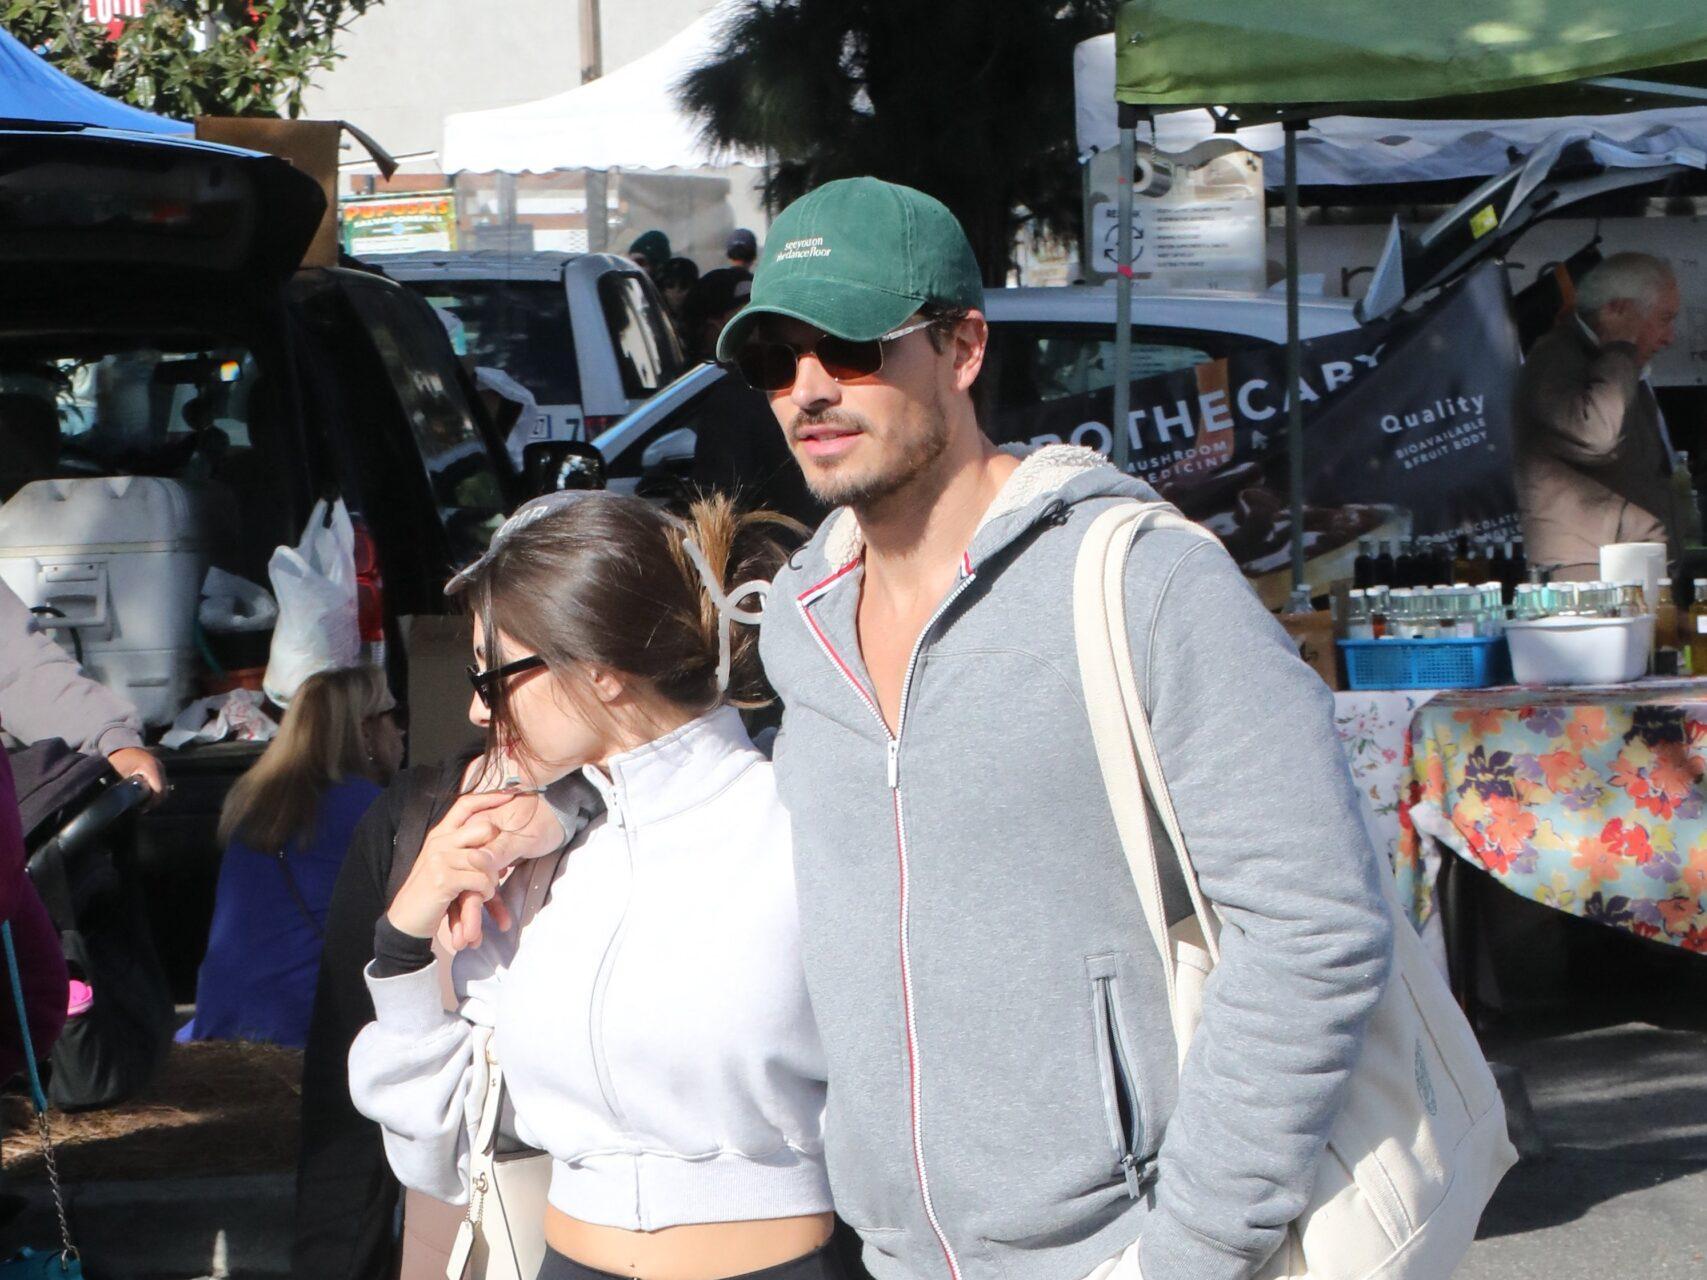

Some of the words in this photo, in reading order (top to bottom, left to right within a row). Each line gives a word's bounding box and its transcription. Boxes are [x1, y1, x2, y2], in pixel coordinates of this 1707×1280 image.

[1380, 394, 1485, 433] Quality
[1396, 417, 1486, 459] BIOAVAILABLE
[1453, 431, 1488, 450] BODY
[1147, 454, 1231, 484] EDICINE
